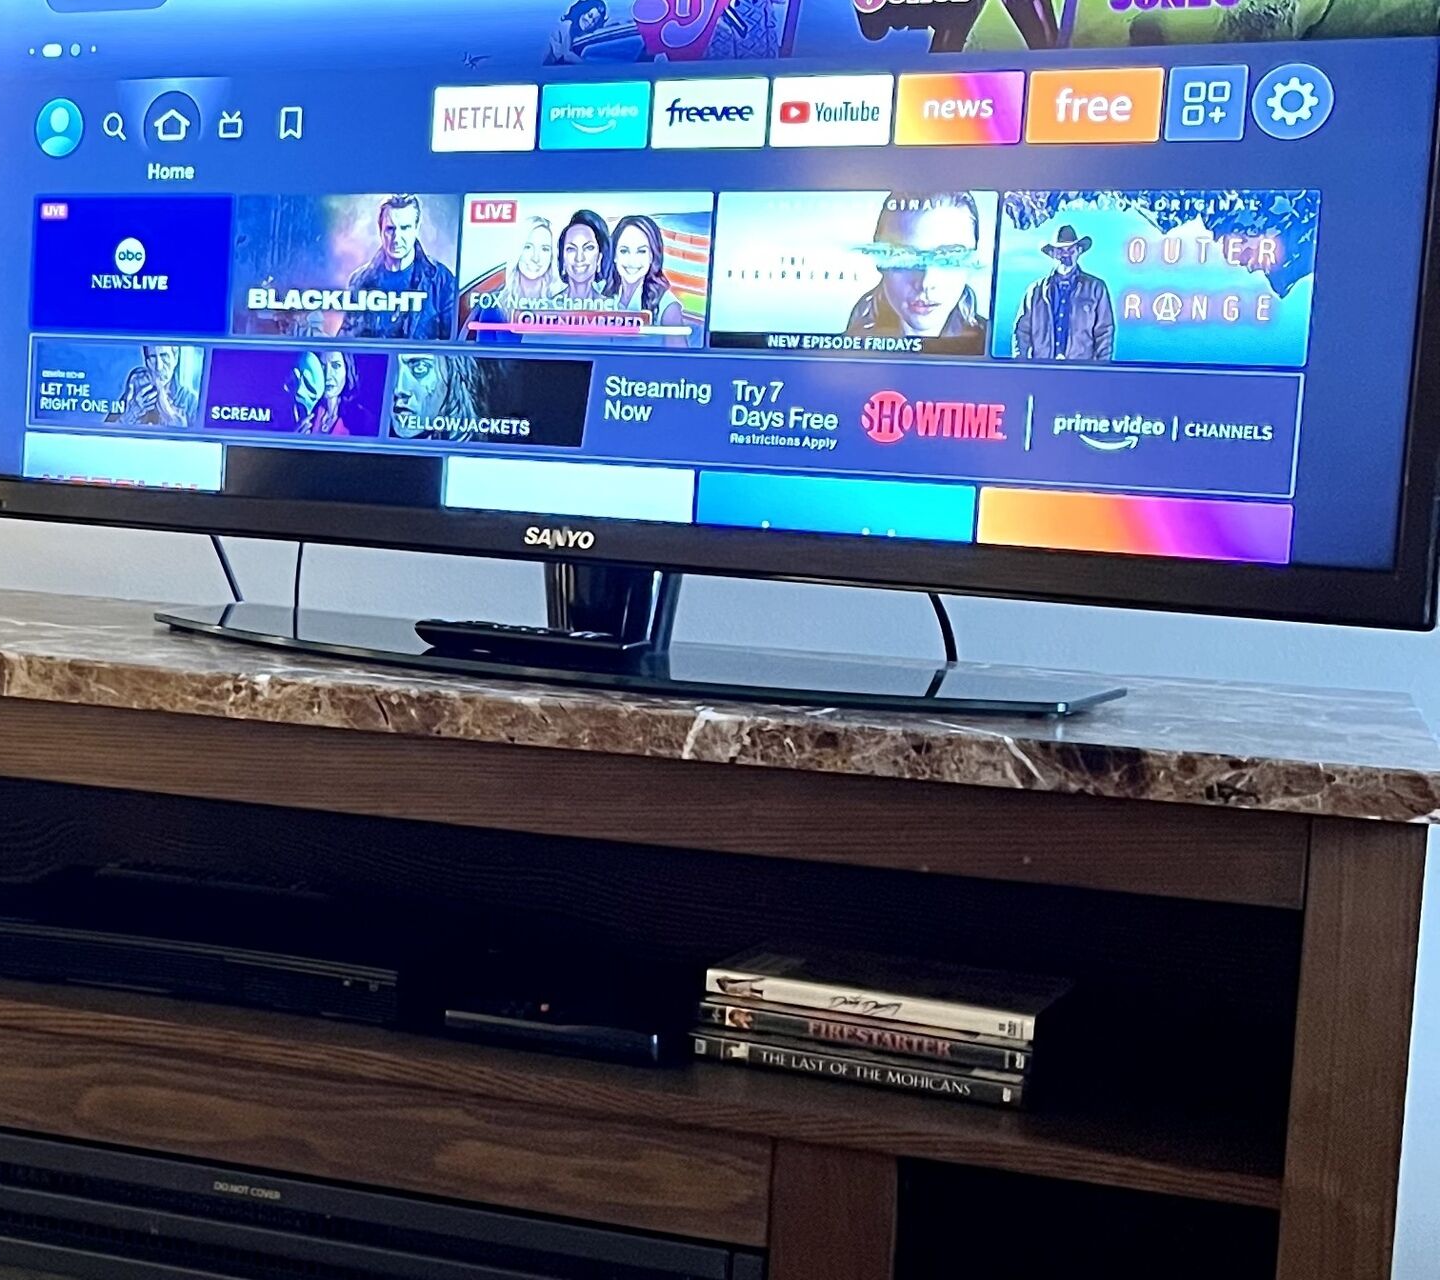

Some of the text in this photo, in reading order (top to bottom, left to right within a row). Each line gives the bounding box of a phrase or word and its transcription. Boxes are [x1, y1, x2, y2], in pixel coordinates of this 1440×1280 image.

[549, 102, 639, 123] prime video
[666, 98, 755, 126] freevee
[815, 100, 880, 122] YouTube
[922, 98, 995, 120] news
[1056, 88, 1133, 123] free
[443, 105, 525, 132] NETFLIX
[147, 163, 195, 181] Home
[474, 203, 513, 221] LIVE
[118, 249, 143, 262] abc
[1128, 237, 1277, 264] OUTER
[247, 288, 428, 313] BLACKLIGHT
[470, 293, 620, 312] FOX News Channel
[1124, 293, 1273, 322] RANGE
[768, 334, 923, 351] NEW EPISODE FRIDAYS
[40, 383, 90, 397] LET THE
[604, 376, 712, 405] Streaming
[731, 380, 784, 406] Try 7
[40, 399, 125, 413] RIGHT ONE IN
[211, 406, 271, 422] SCREAM
[604, 399, 653, 422] Now
[730, 404, 839, 431] Days Free
[397, 414, 531, 437] YELLOWJACKETS
[1053, 414, 1274, 442] prime video CHANNELS
[729, 432, 838, 451] Restrictions Apply
[523, 526, 595, 550] SANYO
[807, 1021, 952, 1057] FIRESTARTER
[761, 1050, 972, 1097] THE LAST OF THE MOHICANS
[250, 1187, 281, 1200] COVER
